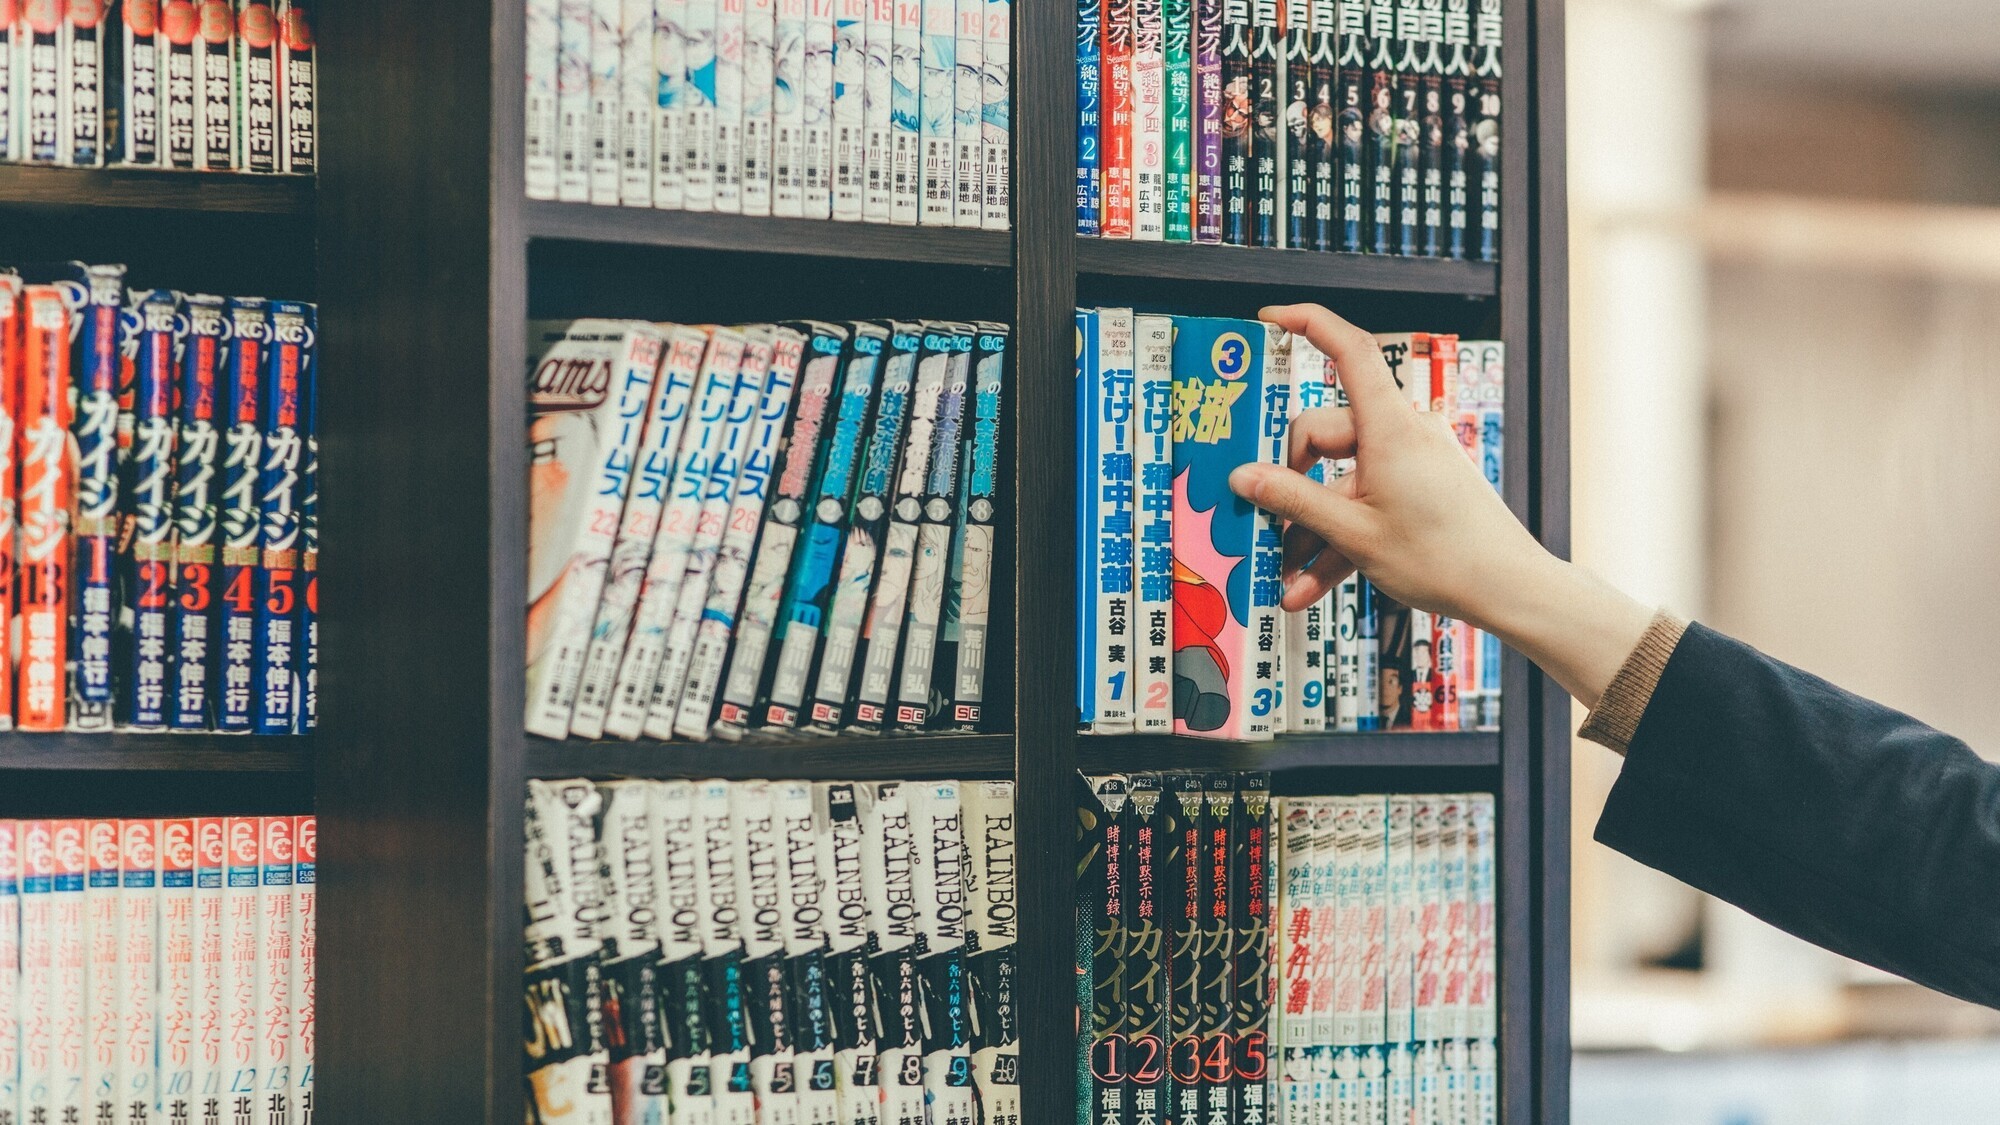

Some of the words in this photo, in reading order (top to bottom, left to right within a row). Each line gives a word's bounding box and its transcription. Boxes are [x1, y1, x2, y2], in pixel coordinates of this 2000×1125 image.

[813, 0, 831, 17] 17
[874, 0, 893, 21] 15
[900, 3, 919, 27] 14
[962, 12, 981, 35] 19
[989, 14, 1009, 39] 21
[250, 56, 271, 151] 福本伸行
[290, 60, 312, 153] 福本伸行
[1081, 64, 1098, 126] 絶望ノ匣
[1113, 64, 1130, 126] 絶望ノ匣
[1142, 72, 1160, 133] 絶望ノ匣
[1171, 71, 1191, 133] 絶望ノ匣
[1203, 73, 1222, 134] 絶望ノ匣
[1261, 79, 1272, 97] 2
[1294, 81, 1305, 99] 3
[1318, 84, 1330, 103] 4
[1347, 86, 1358, 105] 5
[1377, 88, 1390, 109] 6
[1404, 91, 1416, 111] 7
[1427, 91, 1439, 112] 8
[1452, 93, 1465, 114] 9
[1480, 95, 1500, 116] 10
[1083, 137, 1096, 161] 2
[1116, 137, 1125, 160] 1
[1145, 143, 1157, 167] 3
[1172, 142, 1185, 166] 4
[1205, 145, 1218, 168] 5
[927, 158, 938, 199] 川三番地
[959, 161, 969, 203] 川三番地
[986, 164, 998, 206] 川三番地
[234, 319, 263, 338] KC
[274, 325, 303, 342] KC
[979, 336, 1005, 351] GC
[1112, 319, 1126, 328] 432
[1151, 331, 1165, 340] 450
[1219, 339, 1246, 375] 3
[77, 390, 119, 518] カイジ
[599, 369, 651, 500] ドリームス
[638, 372, 690, 503] ドリームス
[678, 373, 731, 502] ドリームス
[705, 373, 759, 504] ドリームス
[738, 370, 791, 500] ドリームス
[24, 416, 68, 561] カイジ
[134, 416, 173, 544] カイジ
[178, 420, 218, 546] カイジ
[222, 422, 262, 548] カイジ
[263, 426, 302, 550] カイジ
[1253, 383, 1291, 607] 行け!卓球部
[591, 510, 617, 536] 22
[732, 509, 757, 533] 26
[88, 538, 107, 582] 1
[20, 563, 62, 605] 13
[139, 564, 167, 608] 2
[180, 564, 210, 611] 3
[223, 567, 253, 612] 4
[267, 571, 294, 614] 5
[138, 612, 164, 710] 福本伸行
[180, 614, 207, 711] 福本伸行
[225, 616, 252, 713] 福本伸行
[265, 619, 292, 714] 福本伸行
[962, 629, 982, 695] 荒川弘
[1107, 671, 1126, 701] 1
[1144, 681, 1169, 709] 2
[1251, 687, 1273, 717] 3
[1302, 680, 1323, 708] 9
[1104, 710, 1127, 718] 講談社
[1145, 719, 1167, 727] 講談社
[1250, 724, 1269, 732] 講談社
[1250, 779, 1262, 787] 674
[1135, 805, 1154, 815] KC
[786, 816, 823, 941] RAINBOW
[883, 812, 916, 939] RAINBOW
[933, 813, 964, 940] RAINBOW
[985, 813, 1016, 939] RAINBOW
[1106, 825, 1120, 916] 賭博黙示録
[1138, 827, 1153, 917] 賭博黙示録
[1185, 828, 1198, 918] 賭博黙示録
[1213, 828, 1227, 918] 賭博黙示録
[1249, 827, 1263, 916] 賭博黙示録
[1093, 916, 1127, 1041] カイジ
[1128, 917, 1163, 1042] カイジ
[1172, 918, 1201, 1041] カイジ
[1203, 917, 1233, 1041] カイジ
[1235, 915, 1268, 1039] カイジ
[816, 1062, 832, 1088] 6
[858, 1057, 874, 1085] 7
[904, 1057, 921, 1085] 8
[952, 1057, 967, 1085] 9
[996, 1057, 1017, 1085] 10
[1104, 1038, 1120, 1077] 1
[1135, 1039, 1159, 1078] 2
[1180, 1039, 1200, 1079] 3
[1205, 1036, 1229, 1079] 4
[1244, 1037, 1266, 1077] 5
[97, 1072, 113, 1097] 8
[166, 1070, 193, 1095] 10
[202, 1070, 221, 1094] 11
[230, 1068, 256, 1093] 12
[265, 1066, 290, 1090] 13
[648, 1066, 666, 1092] 2
